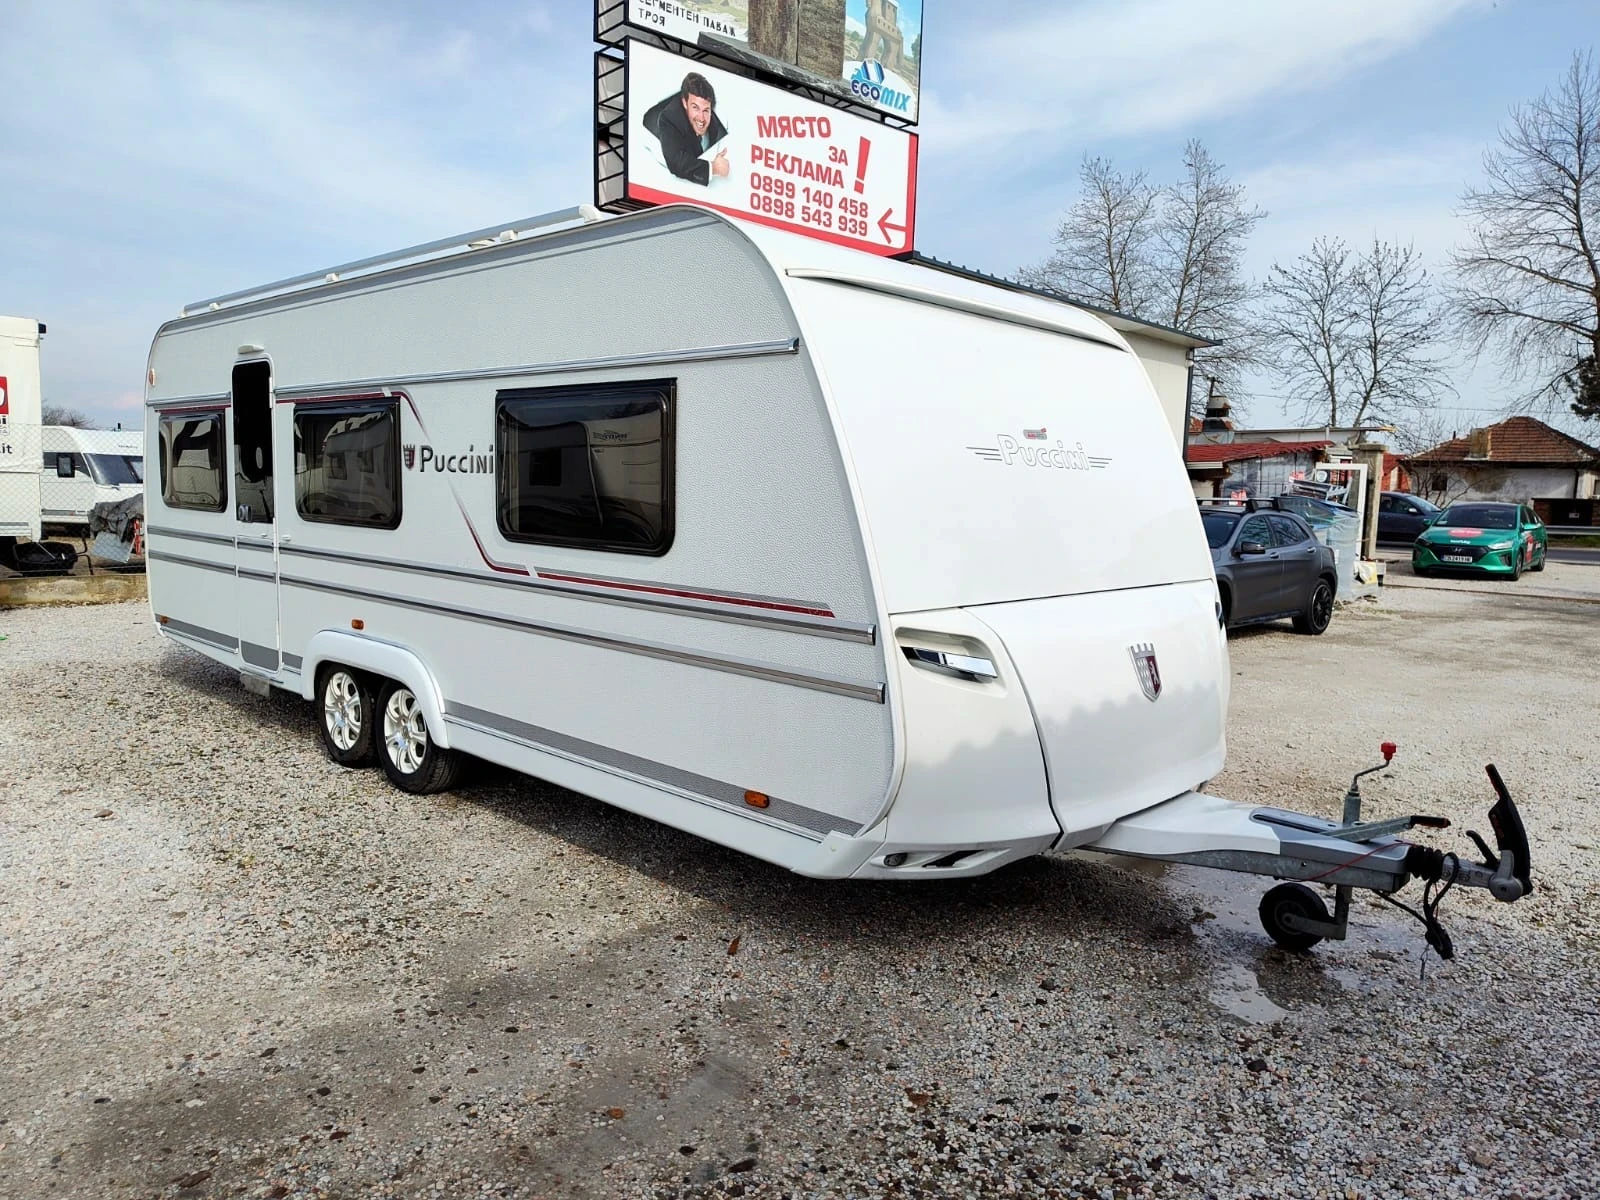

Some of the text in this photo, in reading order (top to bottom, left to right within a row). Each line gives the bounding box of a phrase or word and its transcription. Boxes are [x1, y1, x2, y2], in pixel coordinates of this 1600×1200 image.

[638, 7, 666, 27] ТРОЯ
[757, 115, 832, 138] МЯСТО
[751, 144, 845, 189] РЕКЛАМА
[828, 145, 848, 166] ЗА
[750, 172, 869, 219] 0899 140 458
[750, 192, 868, 237] 0898 543 939
